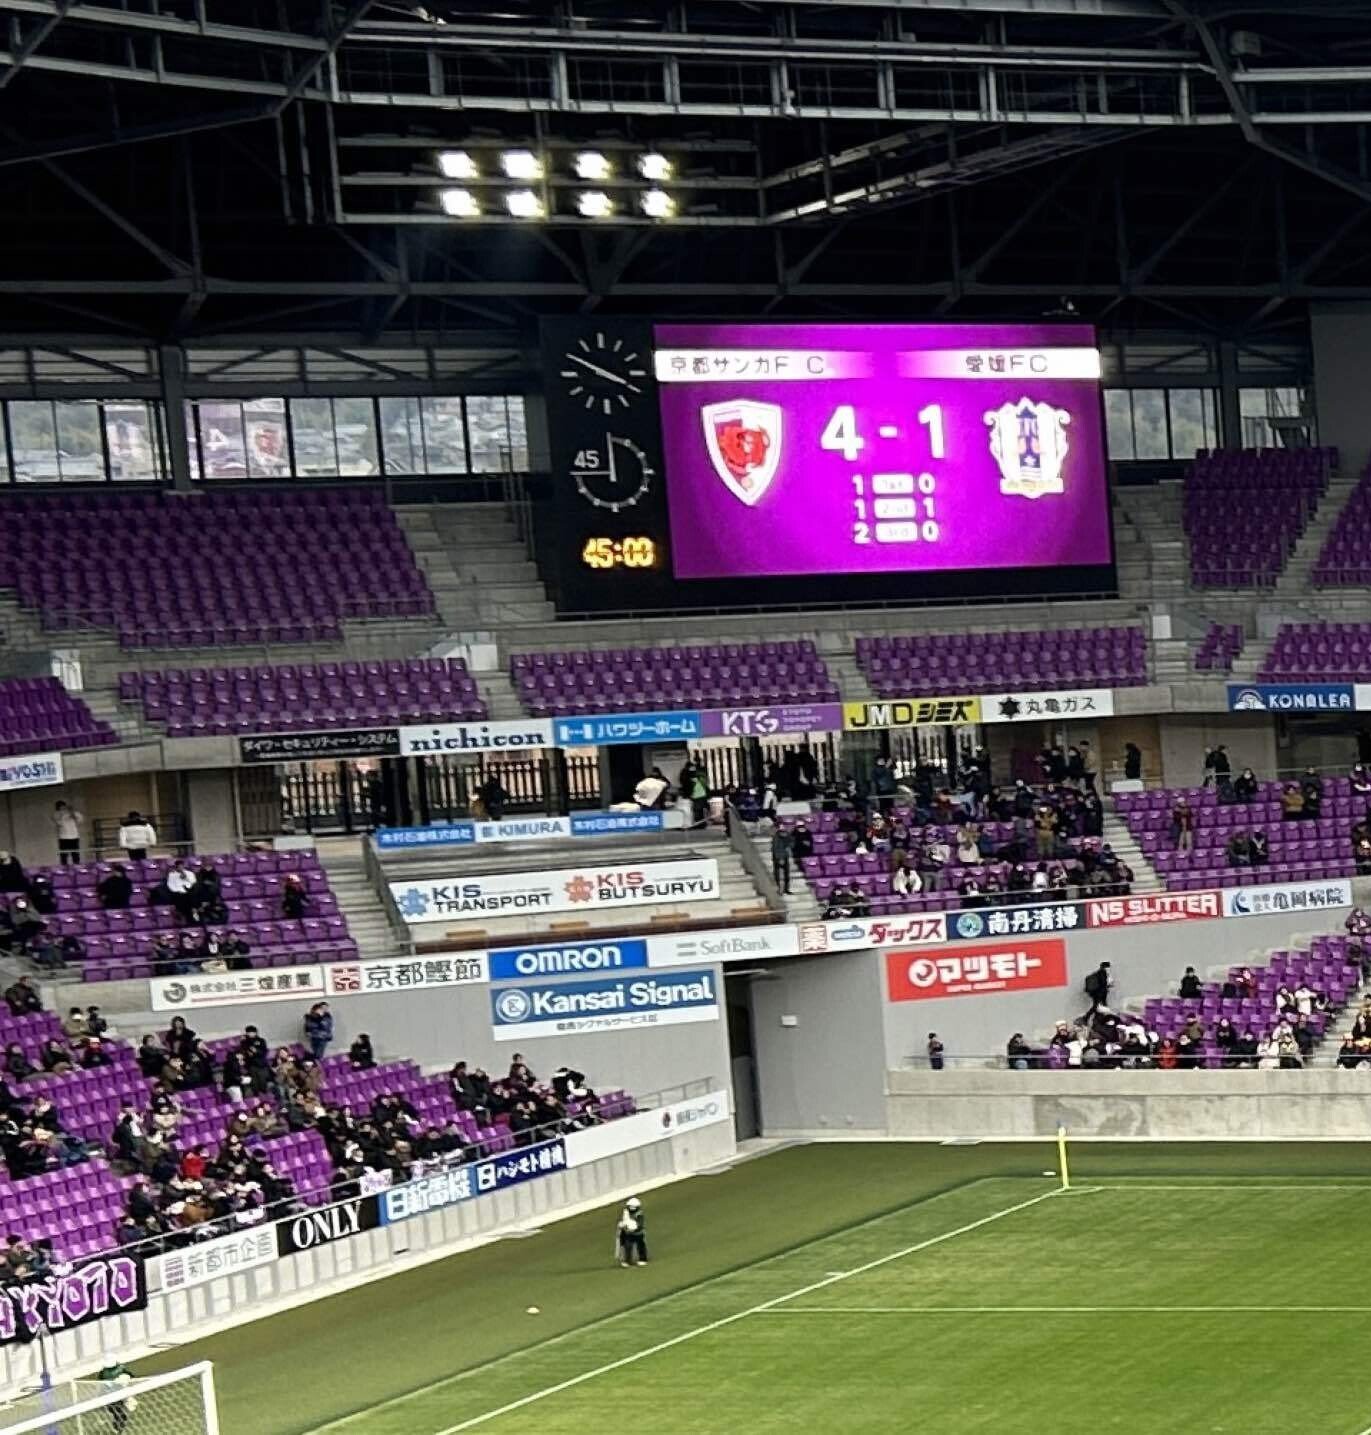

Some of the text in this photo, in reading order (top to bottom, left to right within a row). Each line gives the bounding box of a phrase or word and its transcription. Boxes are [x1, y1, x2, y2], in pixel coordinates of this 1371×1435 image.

[821, 404, 864, 461] 4
[918, 403, 944, 459] 1
[574, 450, 600, 468] 45
[852, 474, 864, 496] 1
[918, 472, 936, 495] 0
[854, 498, 867, 520] 1
[922, 497, 936, 519] 1
[853, 521, 872, 545] 2
[922, 520, 939, 542] 0
[583, 537, 655, 569] 45:00
[1026, 696, 1097, 715] 丸亀ガス
[410, 726, 546, 752] nichicon
[498, 820, 565, 838] KIMURA
[596, 871, 645, 888] KIS
[599, 880, 714, 900] BUTSURYU
[432, 884, 482, 901] KIS
[436, 892, 552, 913] TRANSPORT
[987, 905, 1079, 935] 南丹清掃
[1091, 893, 1218, 927] NS SLITTER
[868, 918, 943, 944] ダックス
[700, 936, 772, 957] SoftBank
[515, 945, 622, 974] OMRON
[935, 951, 1042, 984] マツモト
[365, 957, 482, 989] 京都鰹節
[532, 976, 714, 1016] Kansai Signal
[293, 1200, 362, 1250] ONLY
